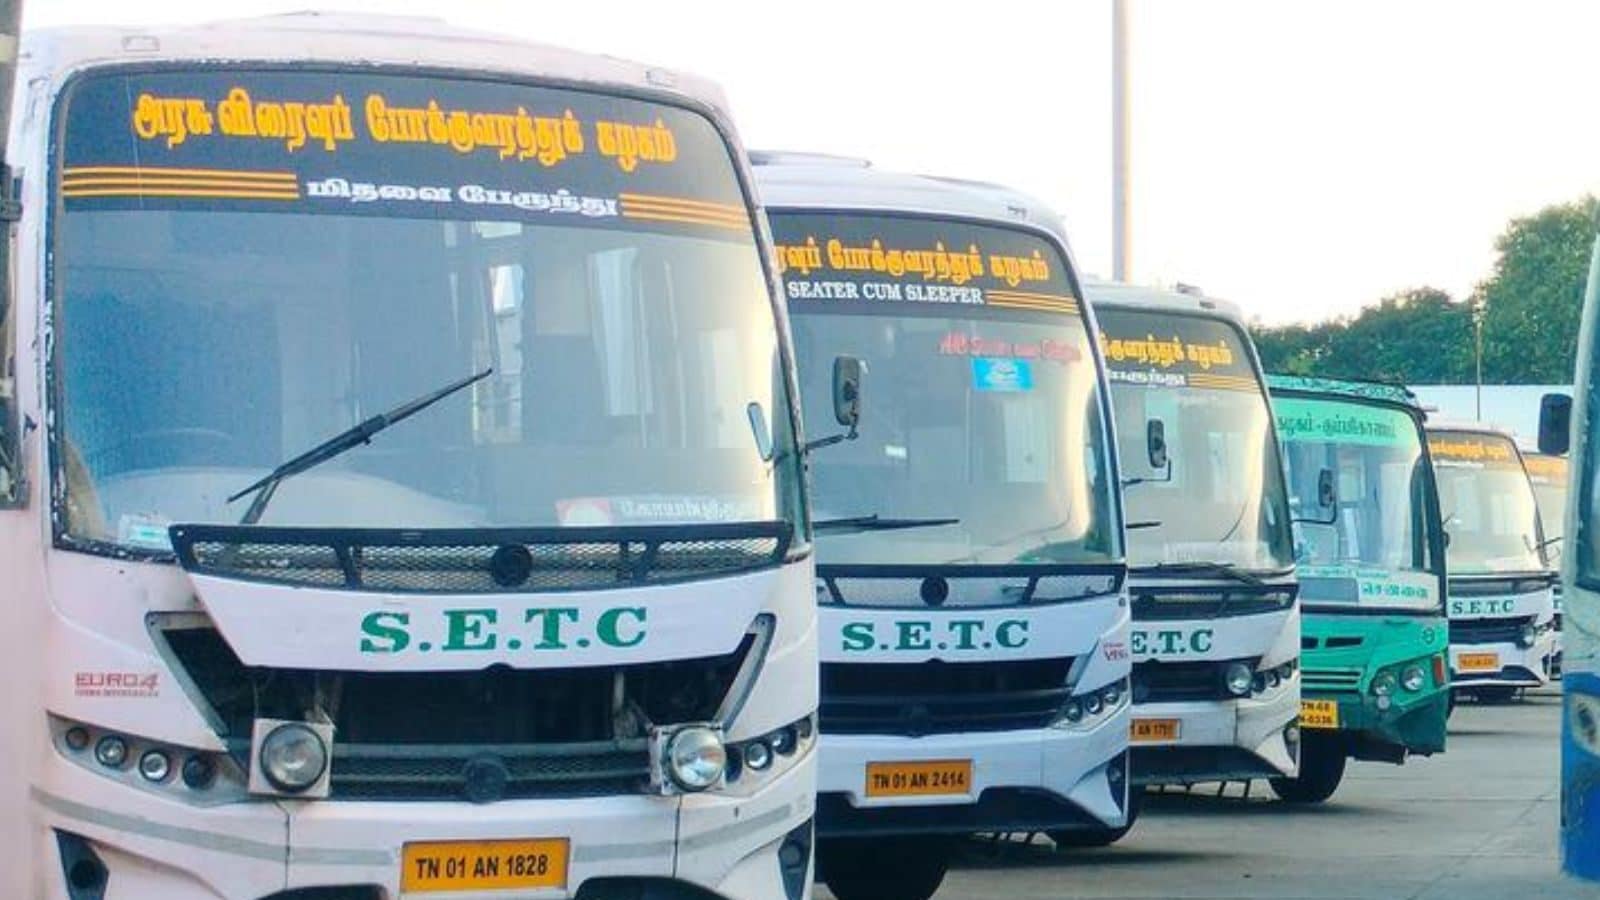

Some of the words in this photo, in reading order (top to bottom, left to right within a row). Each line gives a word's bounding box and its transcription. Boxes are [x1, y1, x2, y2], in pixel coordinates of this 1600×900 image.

[134, 94, 213, 149] அரசு
[364, 94, 584, 167] போக்குவரத்துக்
[596, 116, 677, 173] கழகம்
[306, 178, 452, 202] மிதவை
[459, 184, 618, 217] பேருந்து
[827, 239, 984, 286] போக்குவரத்துக்
[990, 250, 1049, 287] கழகம்
[787, 281, 860, 300] SEATER
[863, 283, 901, 300] CUM
[905, 284, 985, 305] SLEEPER
[360, 607, 647, 652] S.E.T.C
[842, 620, 1029, 650] S.E.T.C
[874, 773, 889, 789] TN
[892, 773, 907, 788] 01
[910, 772, 927, 787] AN
[415, 857, 440, 879] TN
[446, 855, 467, 878] 01
[473, 855, 499, 878] AN
[506, 853, 549, 877] 1828
